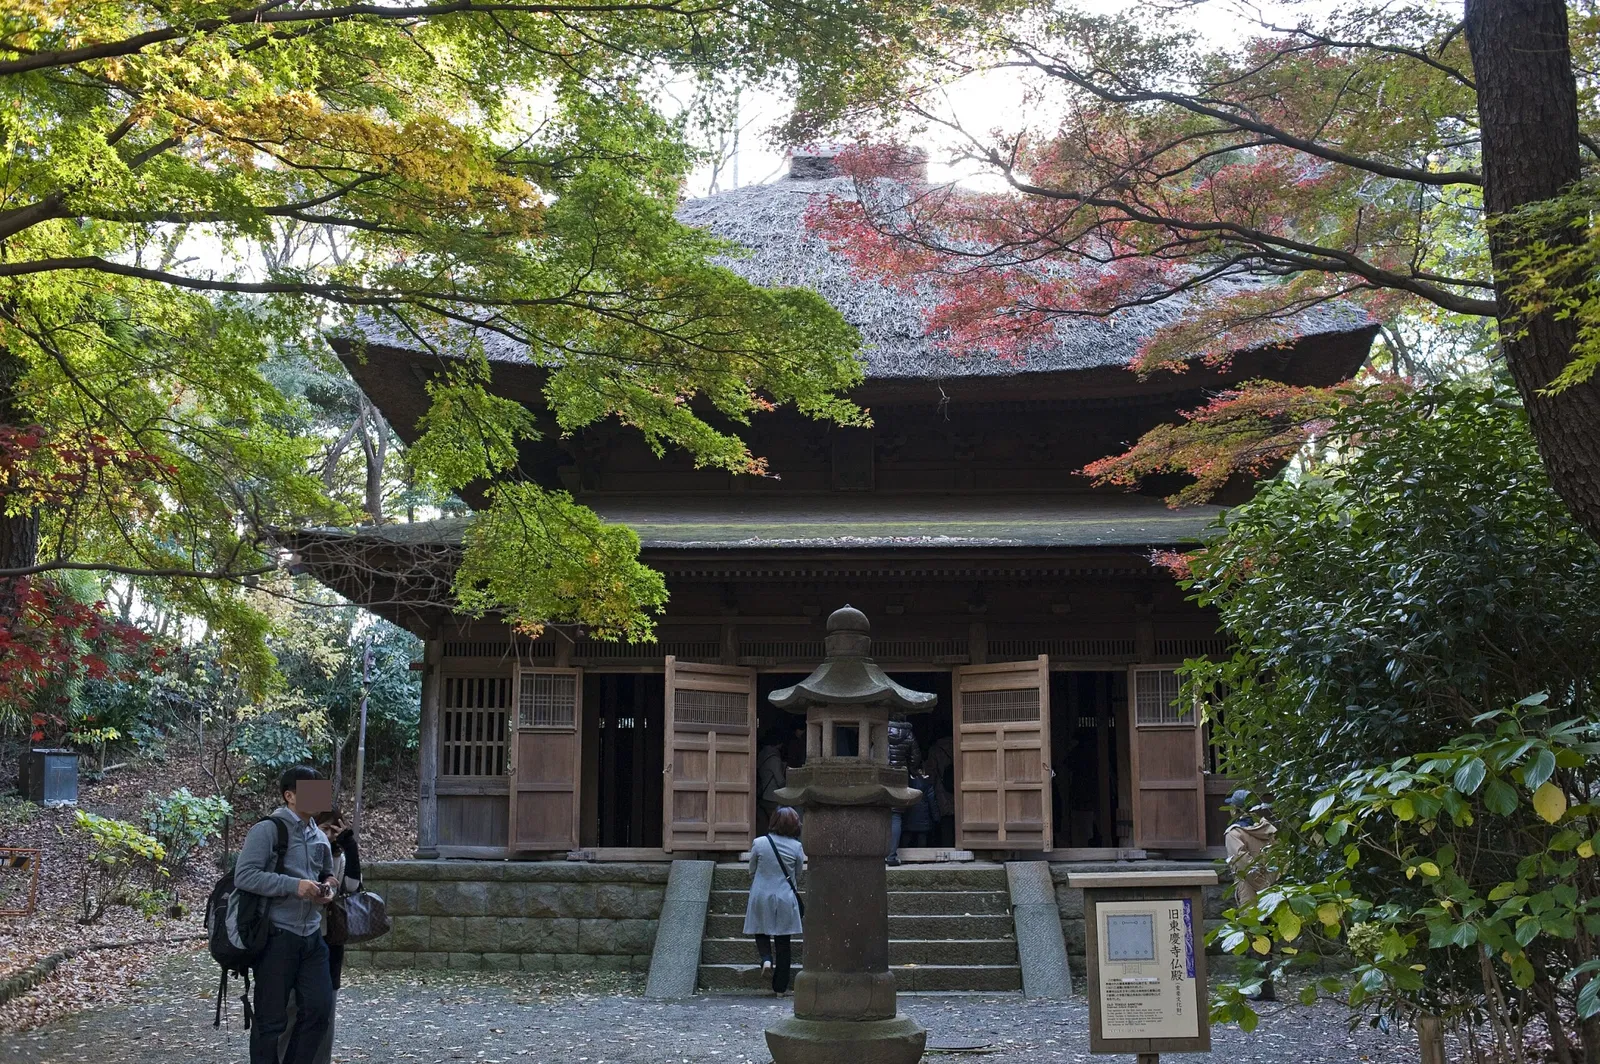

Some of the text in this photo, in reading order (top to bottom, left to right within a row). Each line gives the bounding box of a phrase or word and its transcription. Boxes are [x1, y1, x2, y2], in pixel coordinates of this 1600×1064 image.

[1168, 908, 1184, 982] 旧東慶寺仏殿
